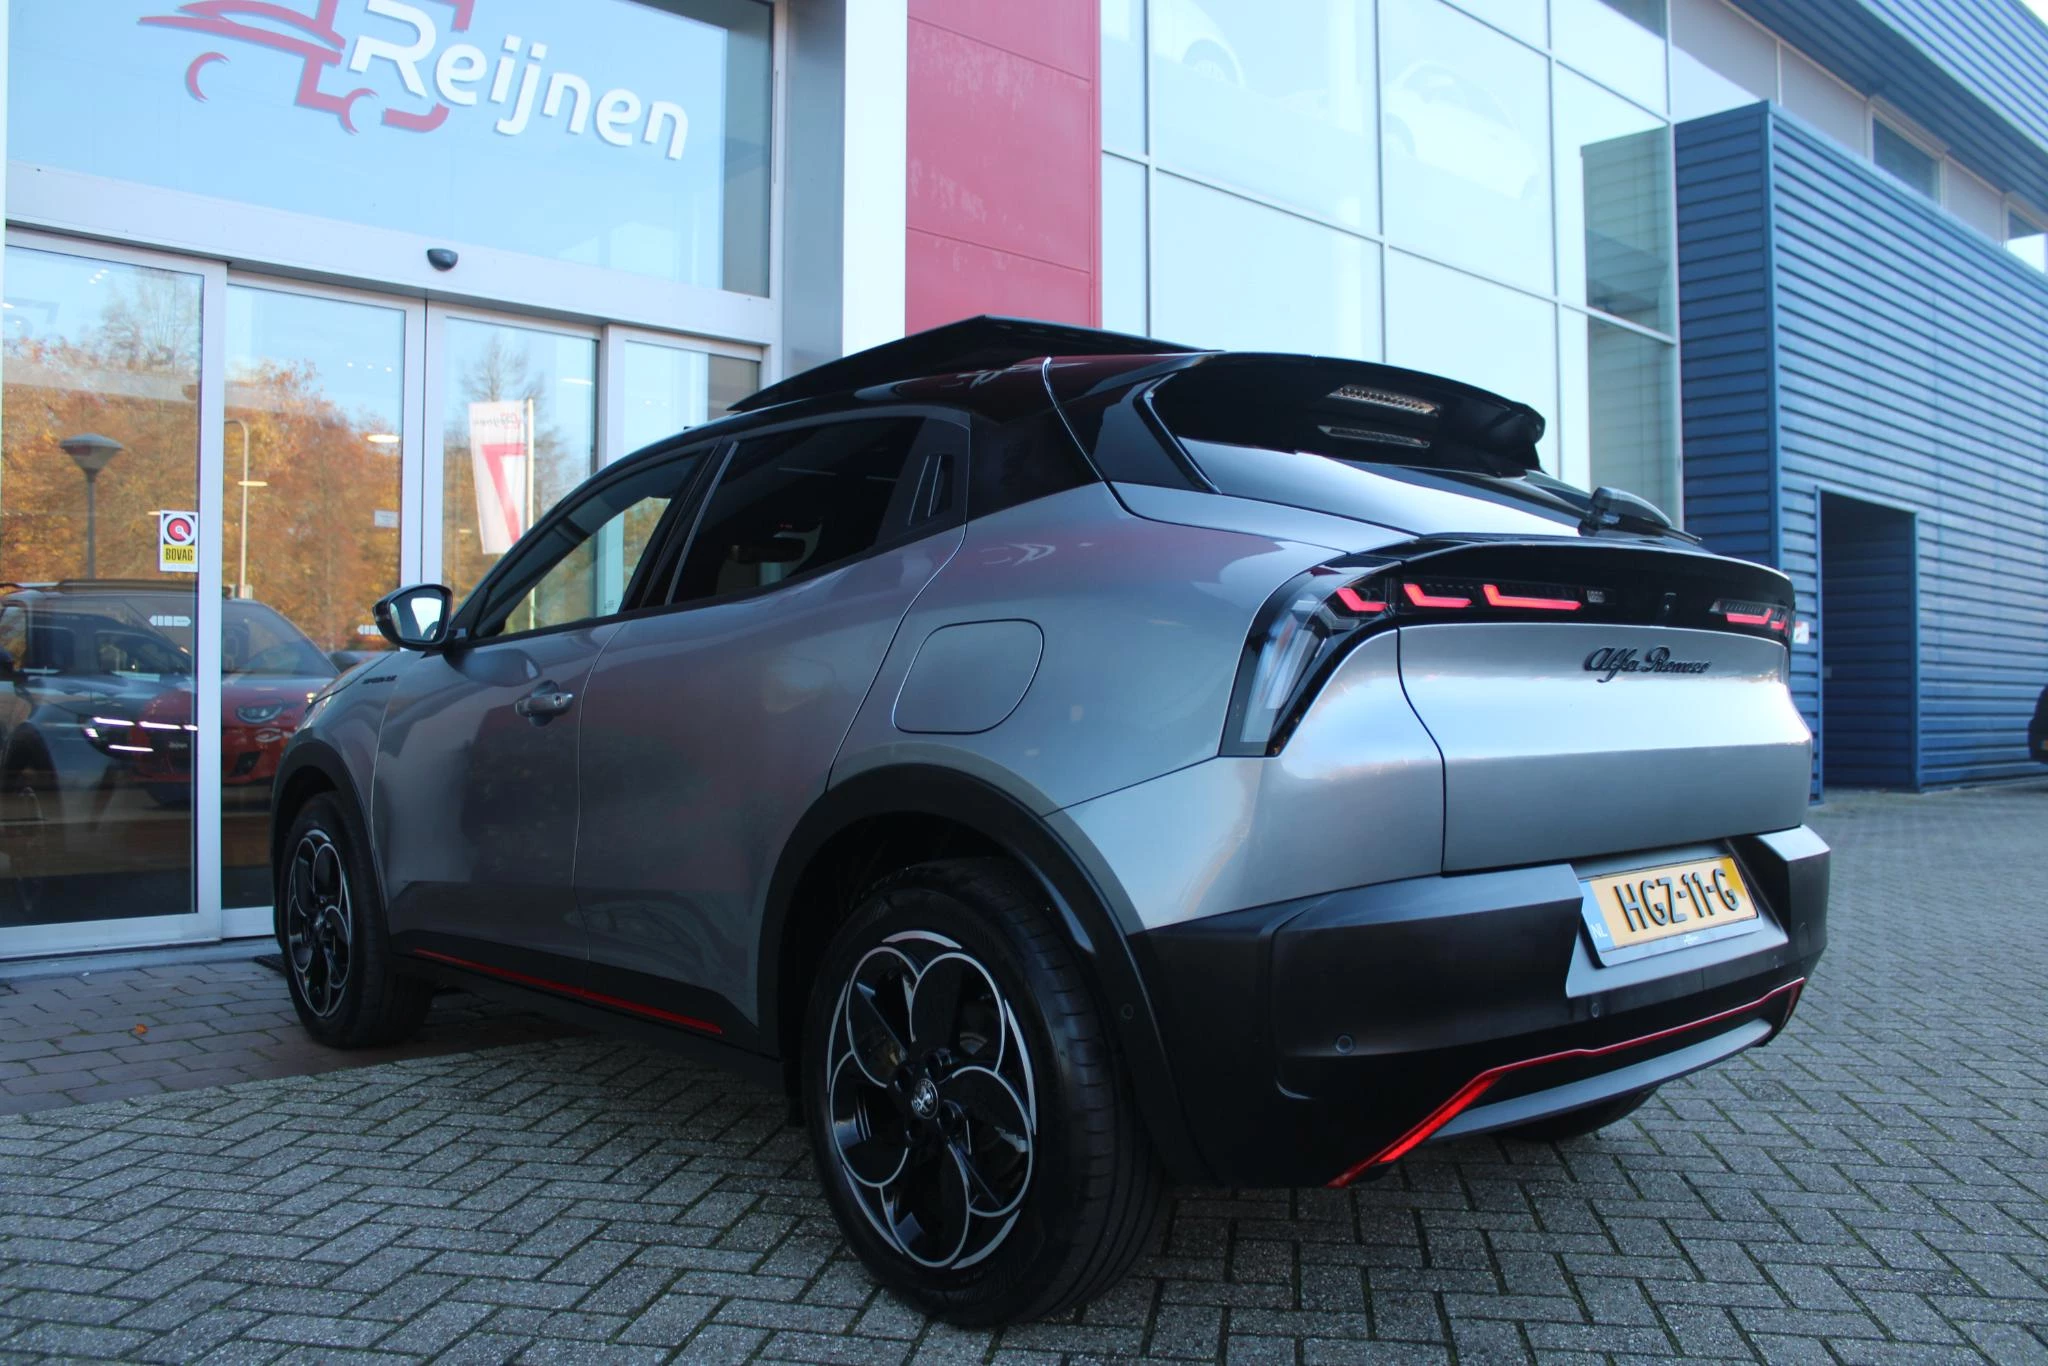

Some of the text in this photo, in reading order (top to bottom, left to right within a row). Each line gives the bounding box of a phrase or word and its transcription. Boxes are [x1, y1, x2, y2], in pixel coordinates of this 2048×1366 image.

[349, 0, 689, 160] Reijnen
[165, 548, 193, 561] BOVAG
[1583, 647, 1640, 683] Alfa
[1614, 868, 1740, 932] HGZ-11-G
[1590, 923, 1608, 938] NL
